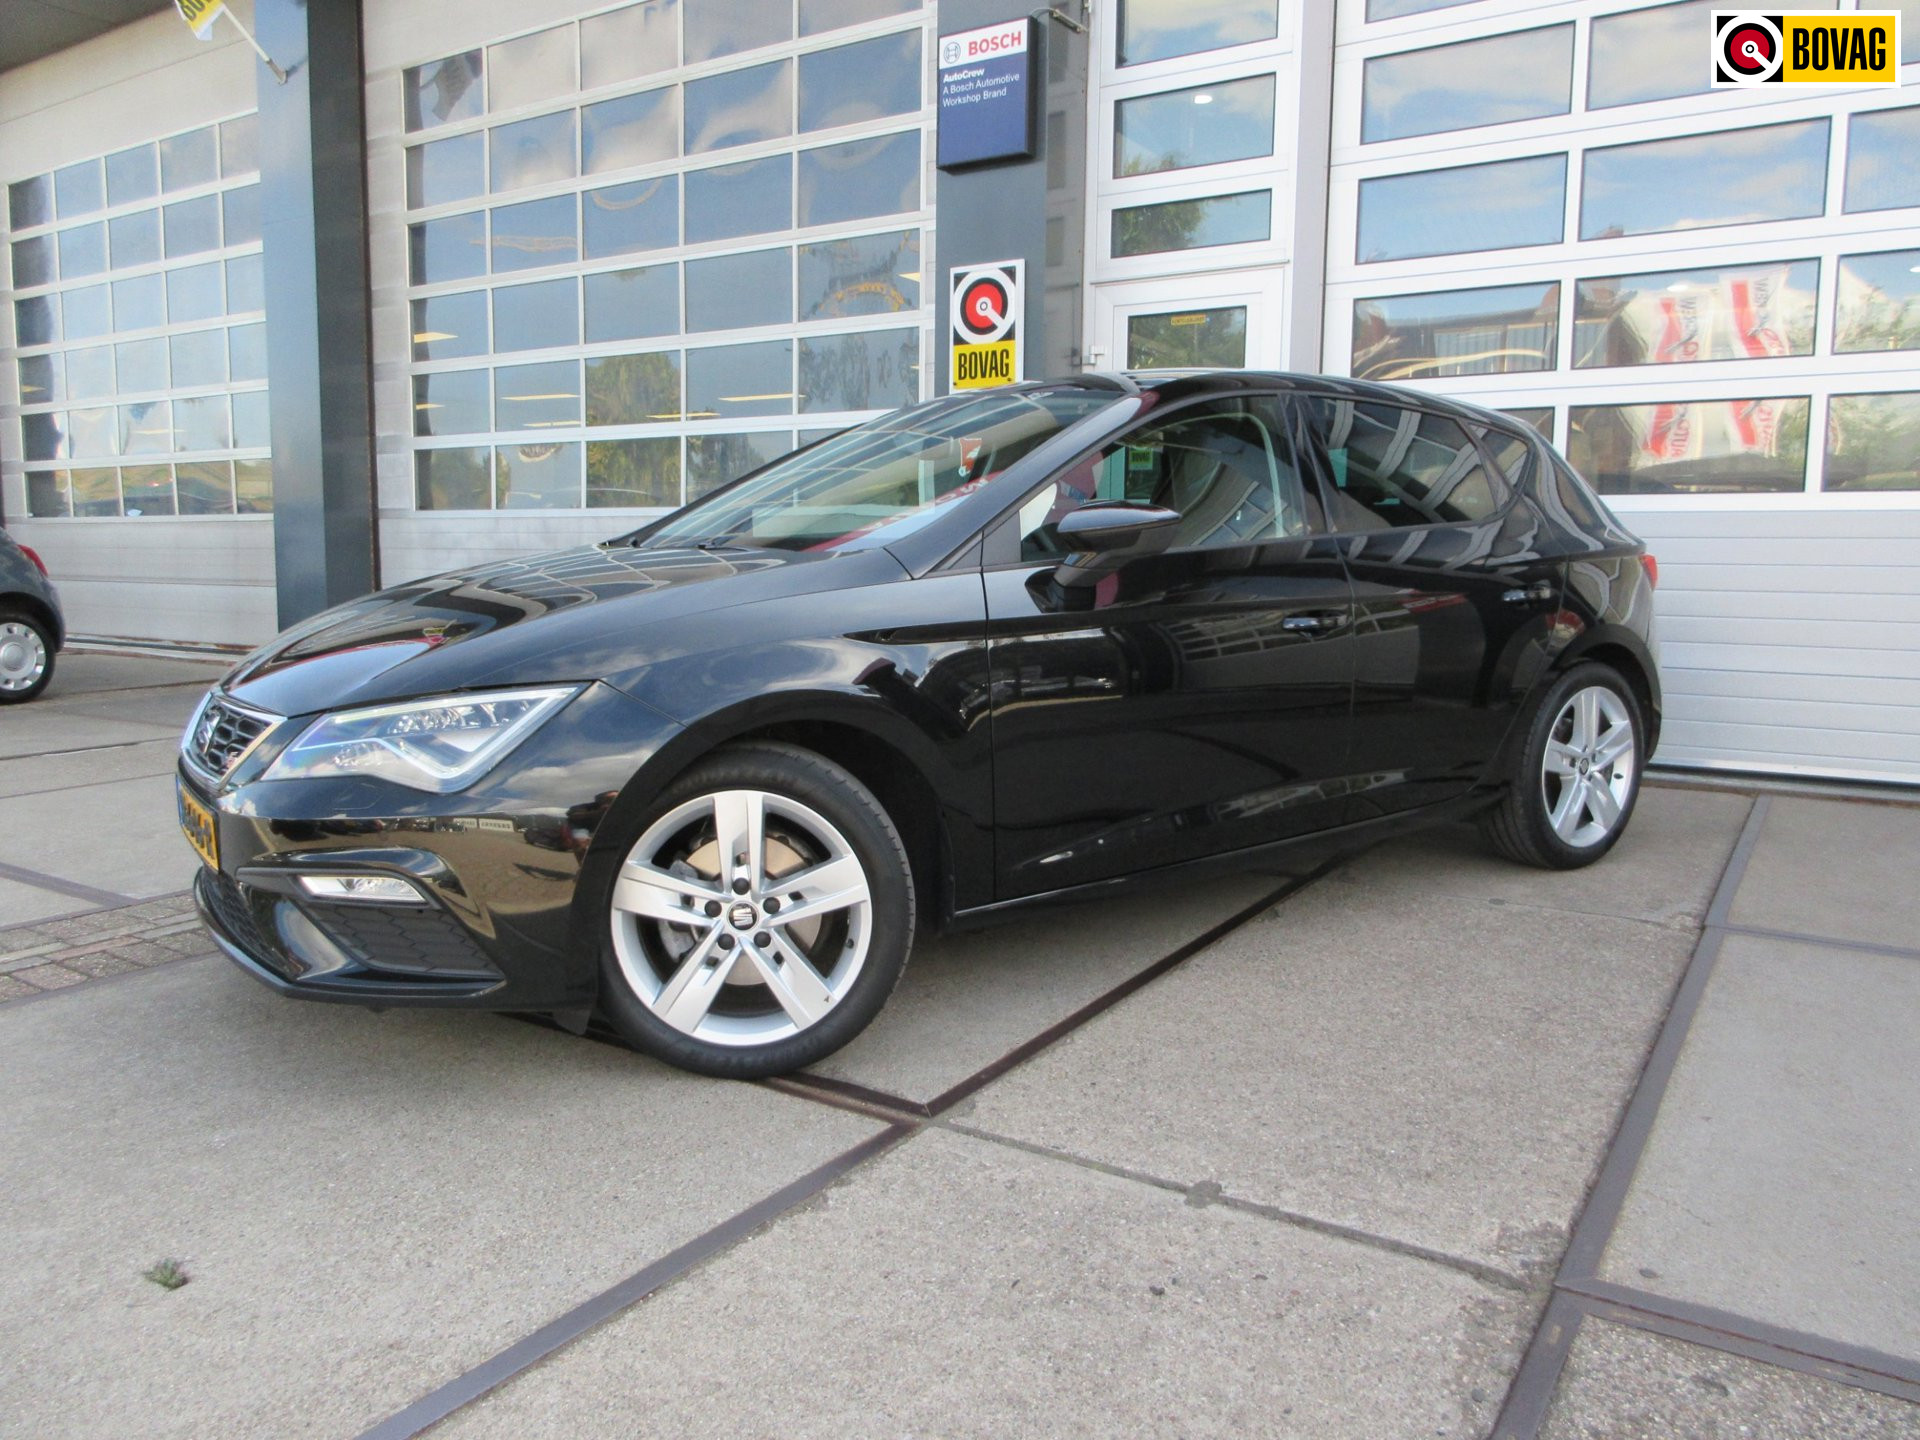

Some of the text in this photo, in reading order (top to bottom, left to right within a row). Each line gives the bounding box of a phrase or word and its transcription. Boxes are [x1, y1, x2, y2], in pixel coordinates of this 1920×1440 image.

[968, 31, 1022, 56] BOSCH
[942, 73, 1020, 95] A Bosch Automotive
[943, 68, 985, 83] AutoCrew
[942, 87, 1007, 107] Workshop Brand
[958, 348, 1010, 381] BOVAG
